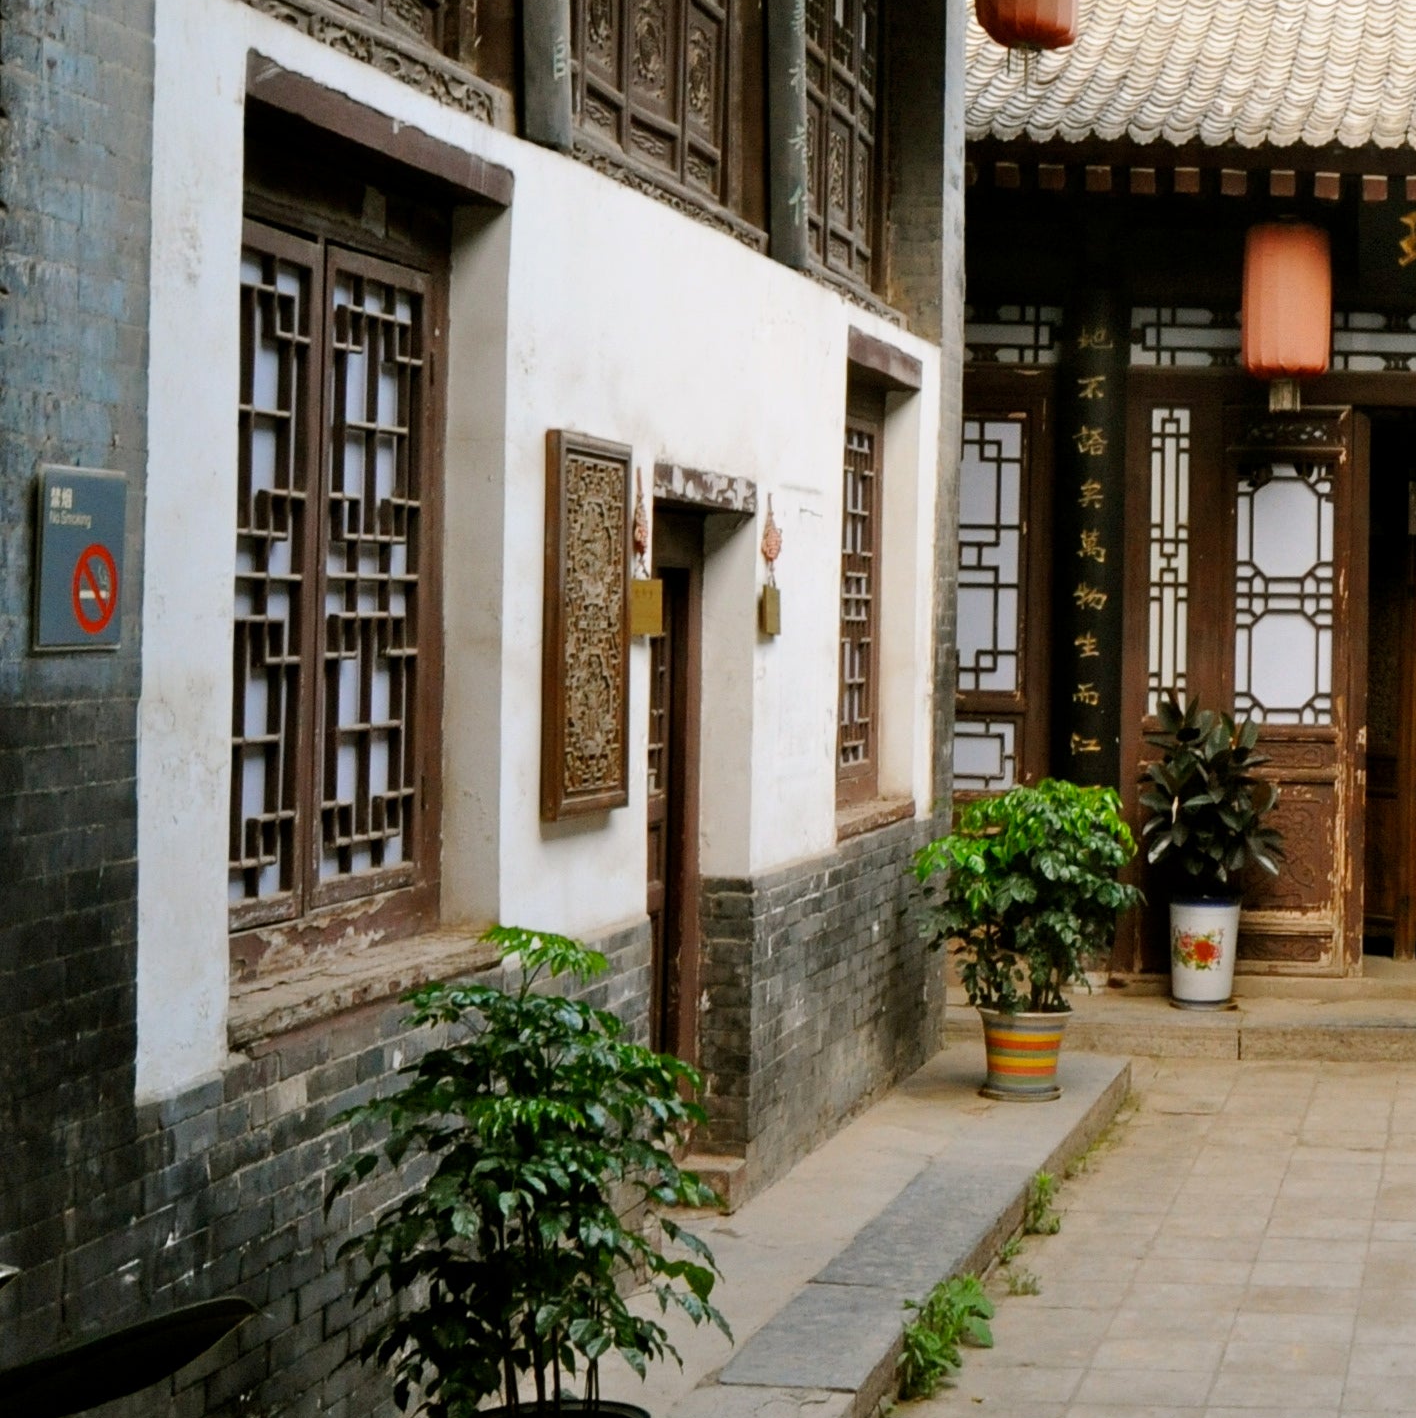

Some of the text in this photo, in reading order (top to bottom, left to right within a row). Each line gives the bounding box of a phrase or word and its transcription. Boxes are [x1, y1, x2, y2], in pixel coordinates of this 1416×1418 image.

[49, 510, 92, 530] No Smoking
[1070, 326, 1114, 790] 地不語矣萬物生而江
